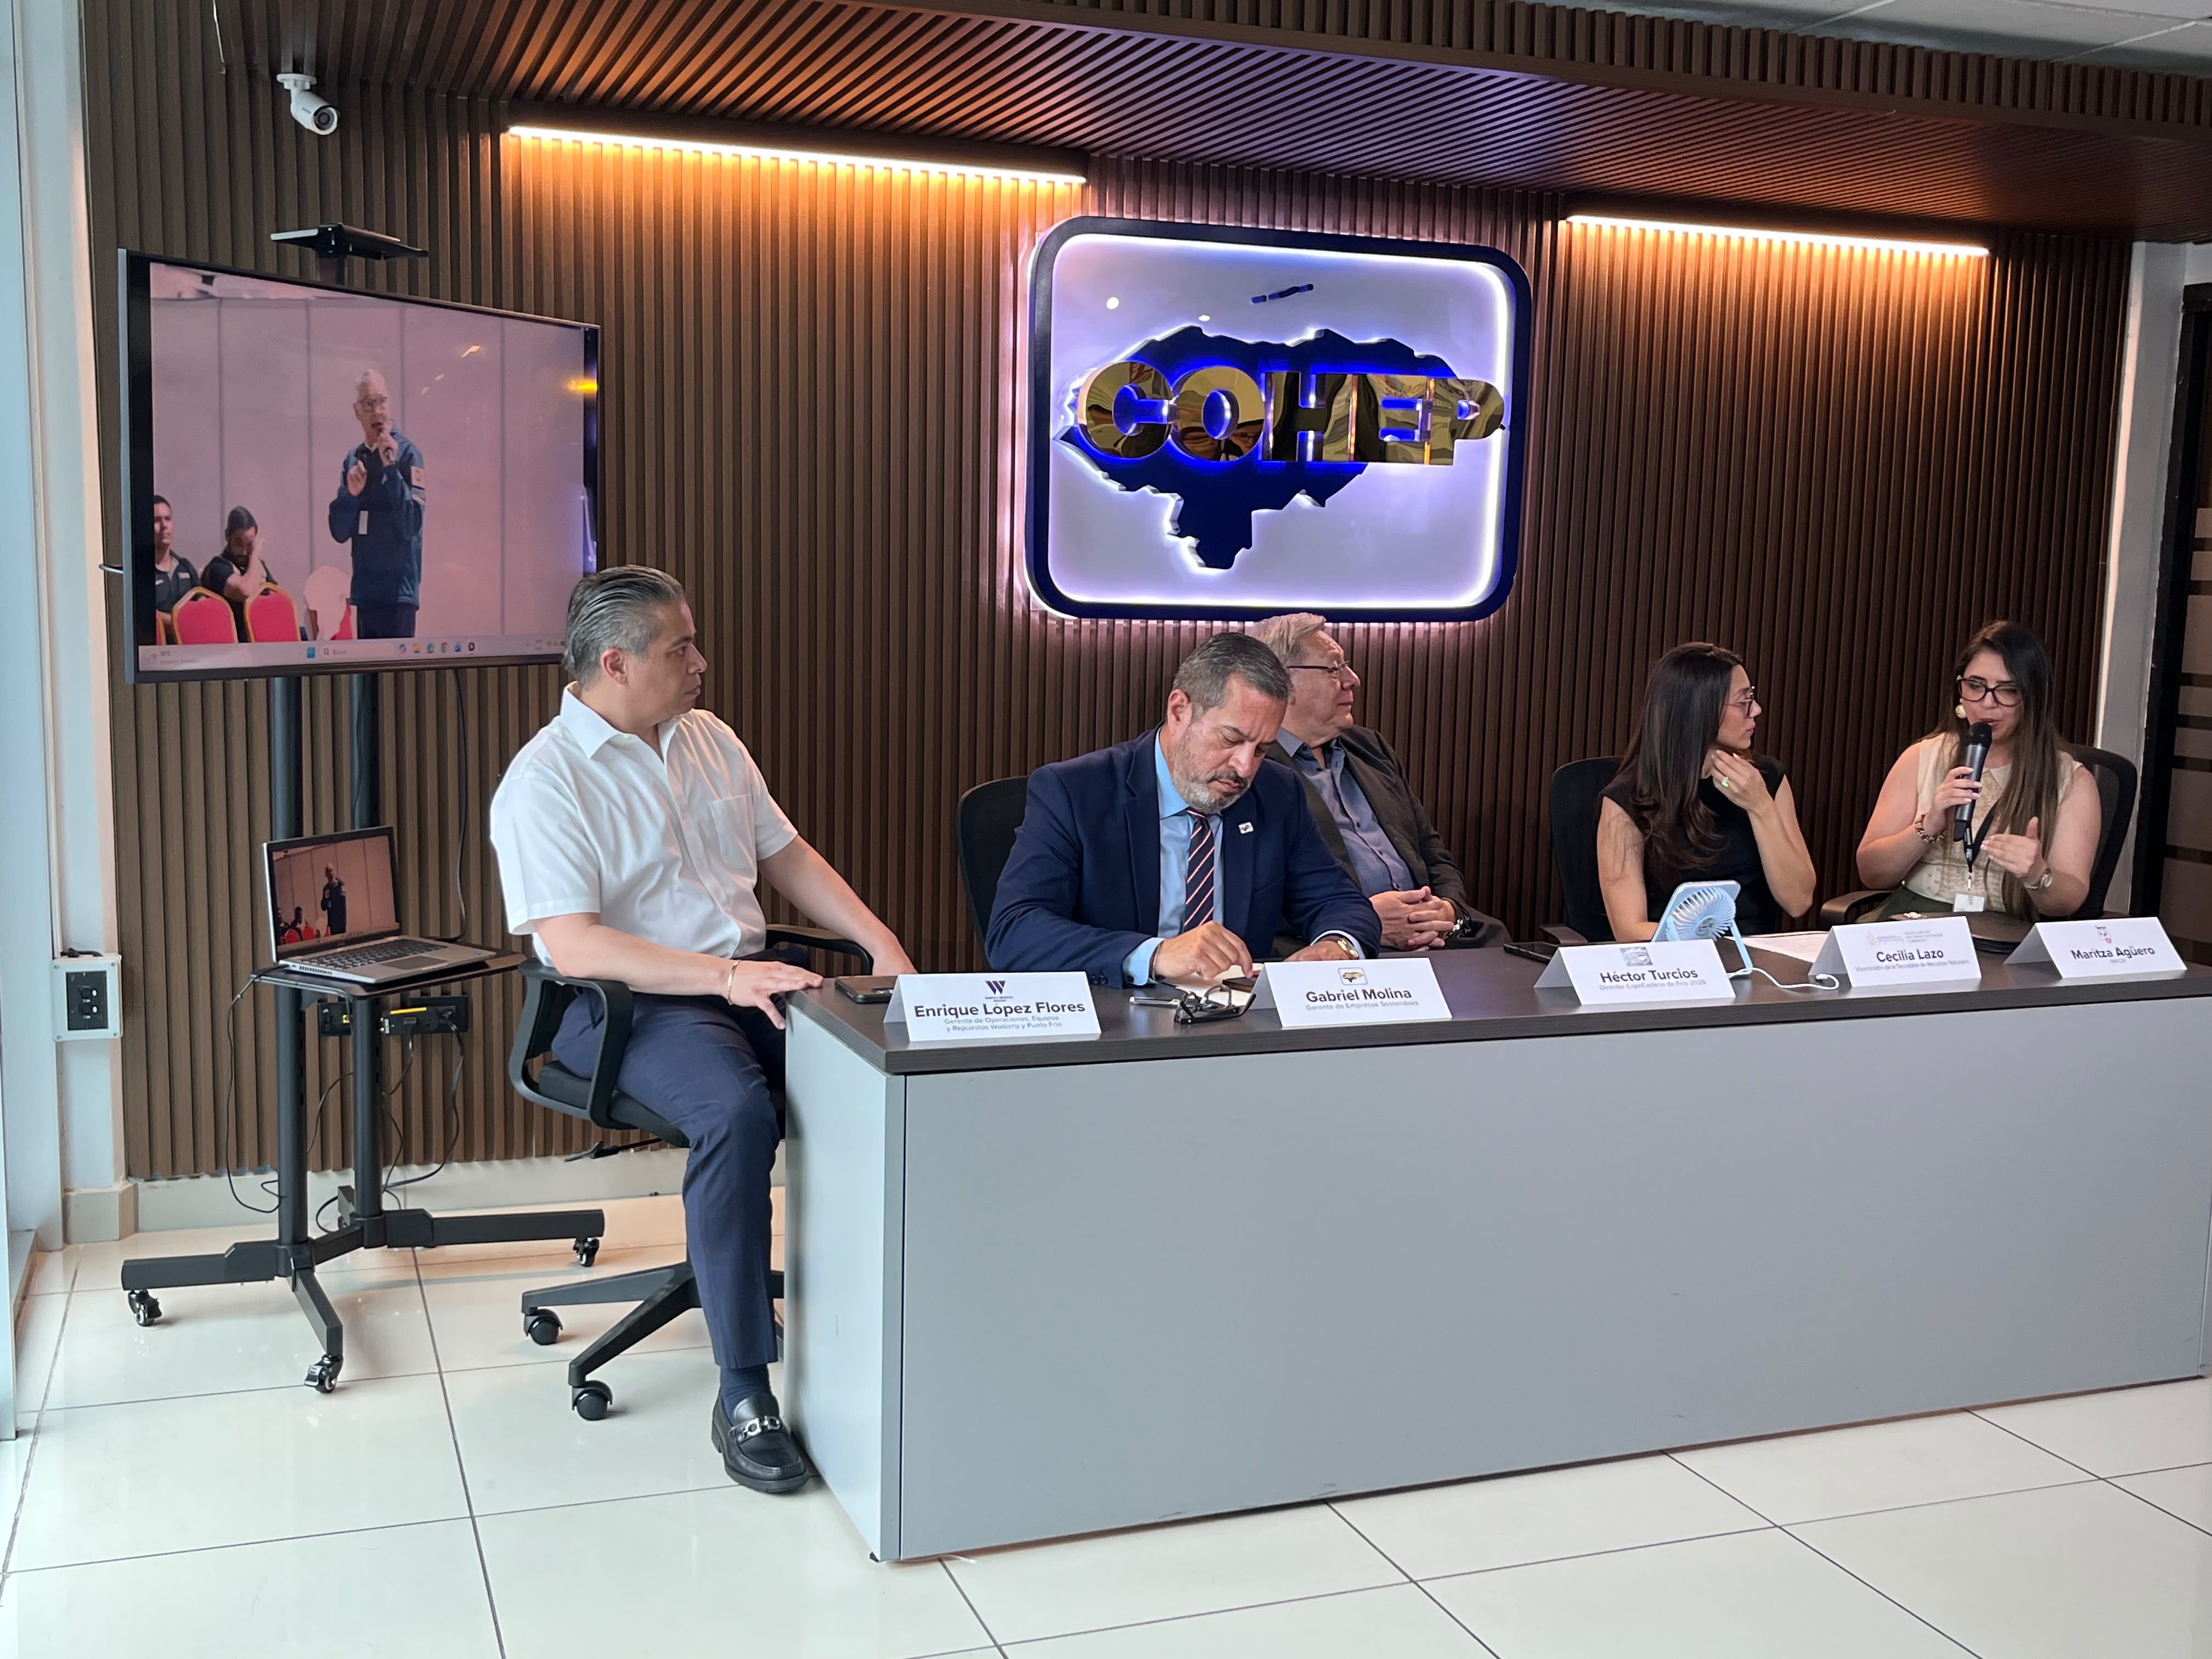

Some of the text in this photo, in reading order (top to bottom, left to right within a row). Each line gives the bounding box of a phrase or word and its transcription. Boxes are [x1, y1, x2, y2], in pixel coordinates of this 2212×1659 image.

[1078, 362, 1504, 465] COHEP
[1876, 949, 1944, 962] Cecilia Lazo
[2071, 946, 2155, 960] Maritza Agüero
[1600, 968, 1698, 983] Héctor Turcios
[1306, 988, 1412, 1002] Gabriel Molina
[914, 1002, 1086, 1019] Enrique López Flores
